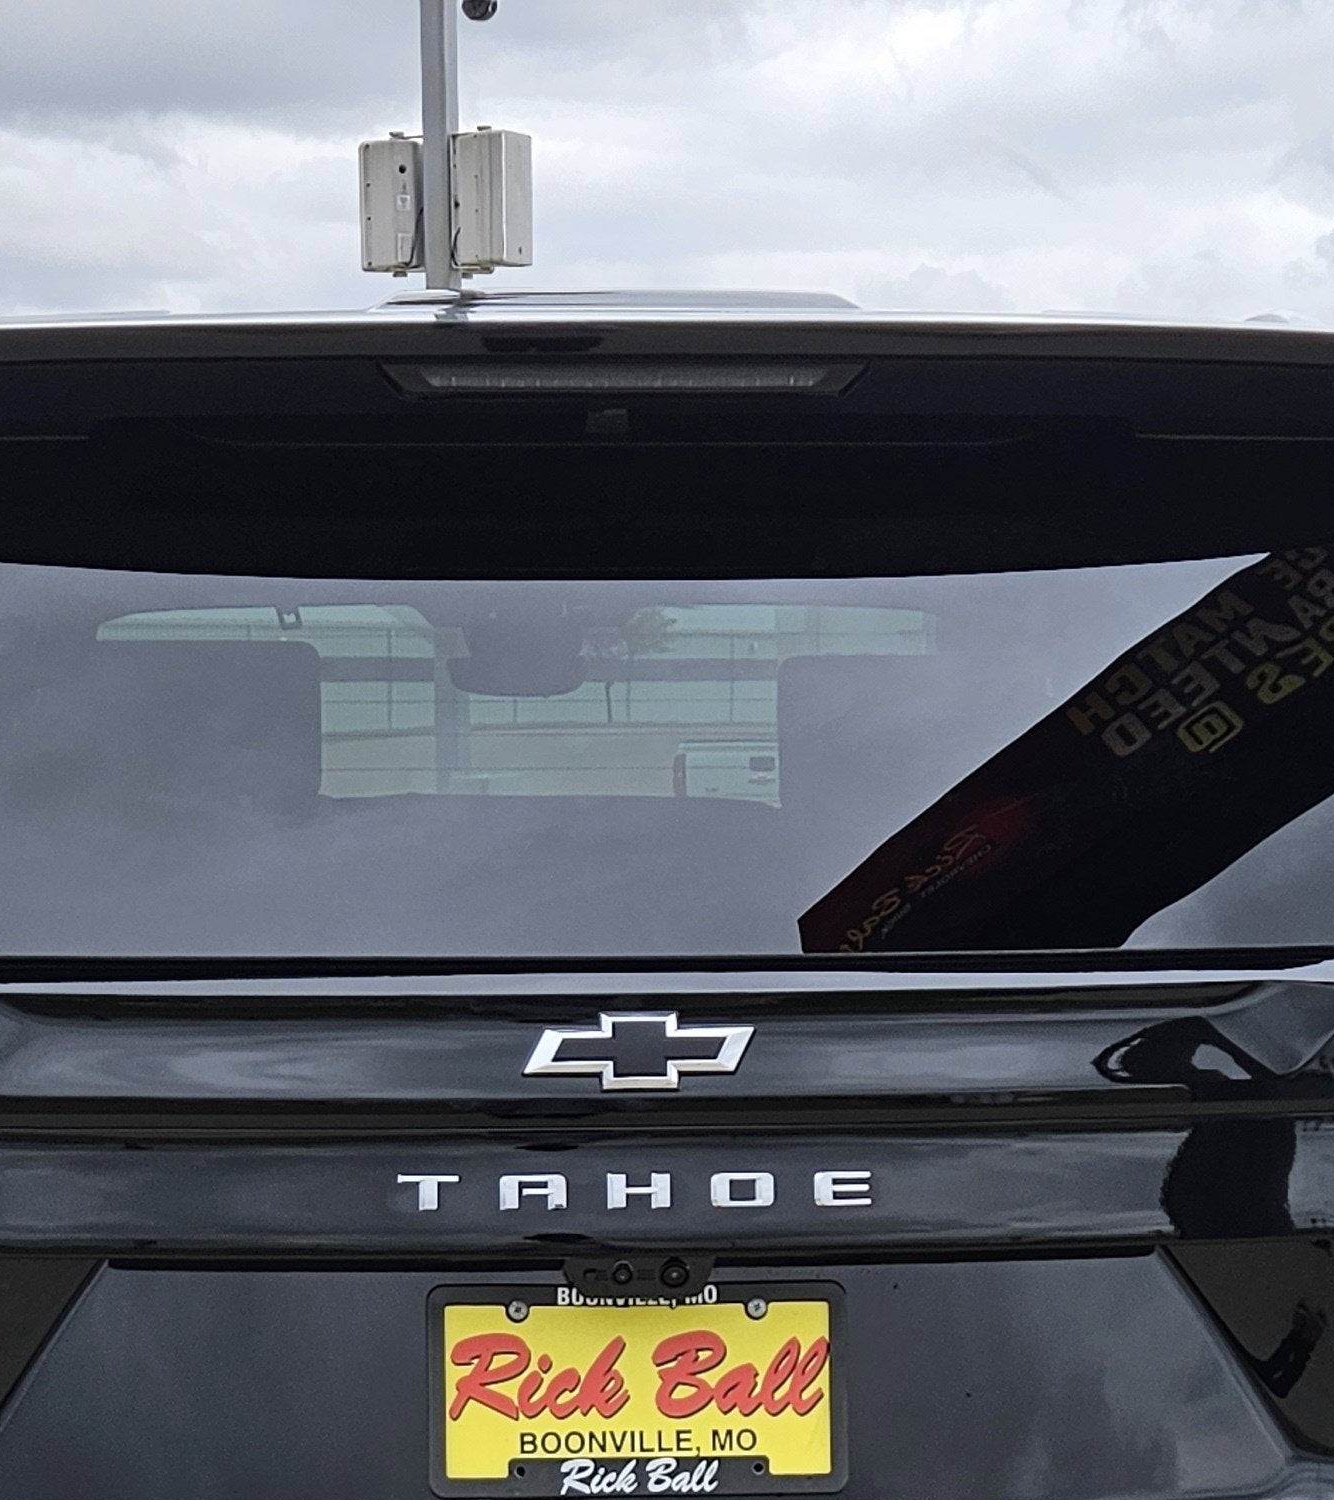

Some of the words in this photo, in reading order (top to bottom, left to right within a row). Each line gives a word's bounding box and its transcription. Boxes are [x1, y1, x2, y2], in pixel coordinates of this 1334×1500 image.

[397, 1170, 873, 1211] TAHOE
[448, 1332, 631, 1421] Rick
[652, 1329, 831, 1419] Ball
[519, 1430, 701, 1457] BOONVILLE,
[711, 1429, 757, 1452] MO
[560, 1460, 640, 1495] Rick
[646, 1460, 719, 1493] Ball
